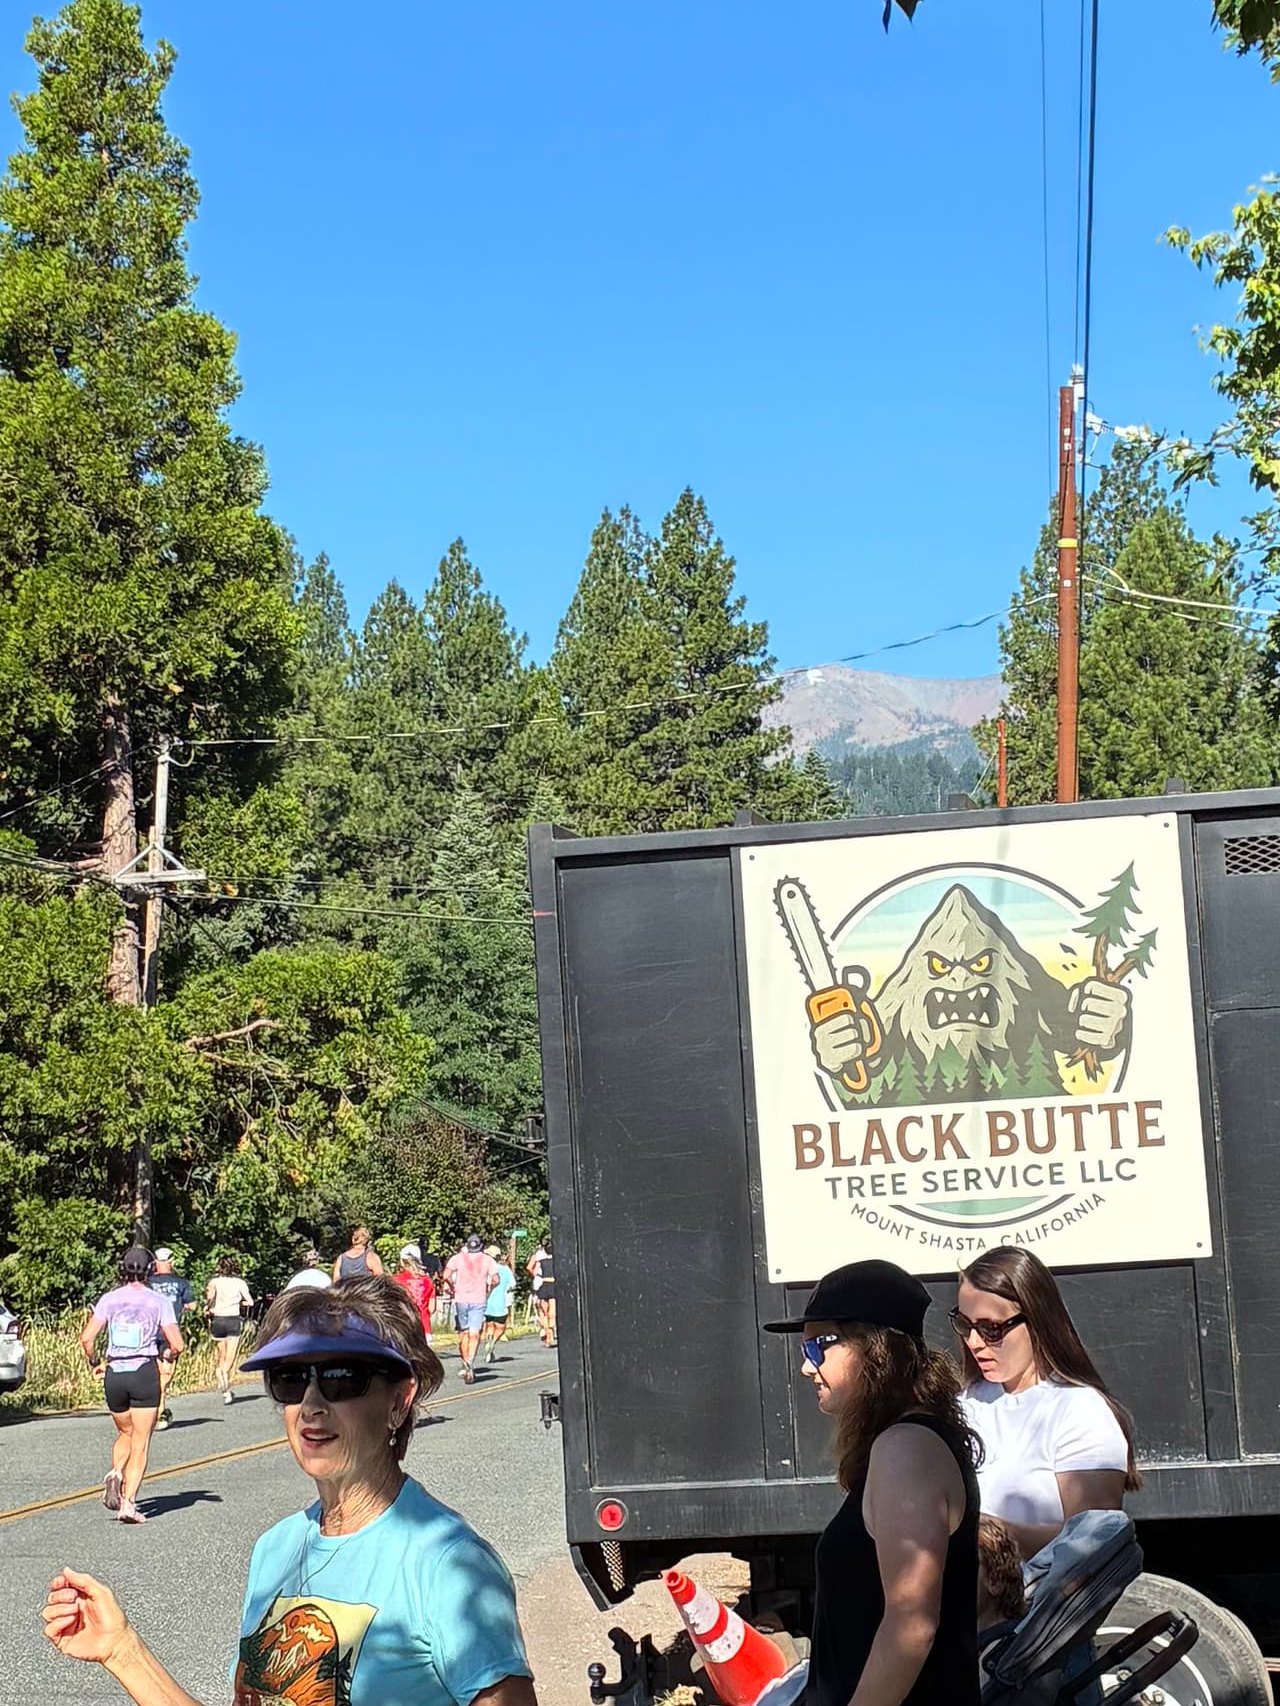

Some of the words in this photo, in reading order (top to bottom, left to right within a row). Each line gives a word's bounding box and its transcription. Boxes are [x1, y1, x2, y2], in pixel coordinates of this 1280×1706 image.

[792, 1112, 971, 1171] BLACK
[985, 1099, 1166, 1158] BUTTE
[824, 1172, 908, 1200] TREE
[922, 1162, 1066, 1193] SERVICE
[1079, 1157, 1137, 1184] LLC
[850, 1202, 915, 1241] MOUNT
[918, 1230, 987, 1251] SHASTA
[1000, 1192, 1107, 1247] CALIFORNIA
